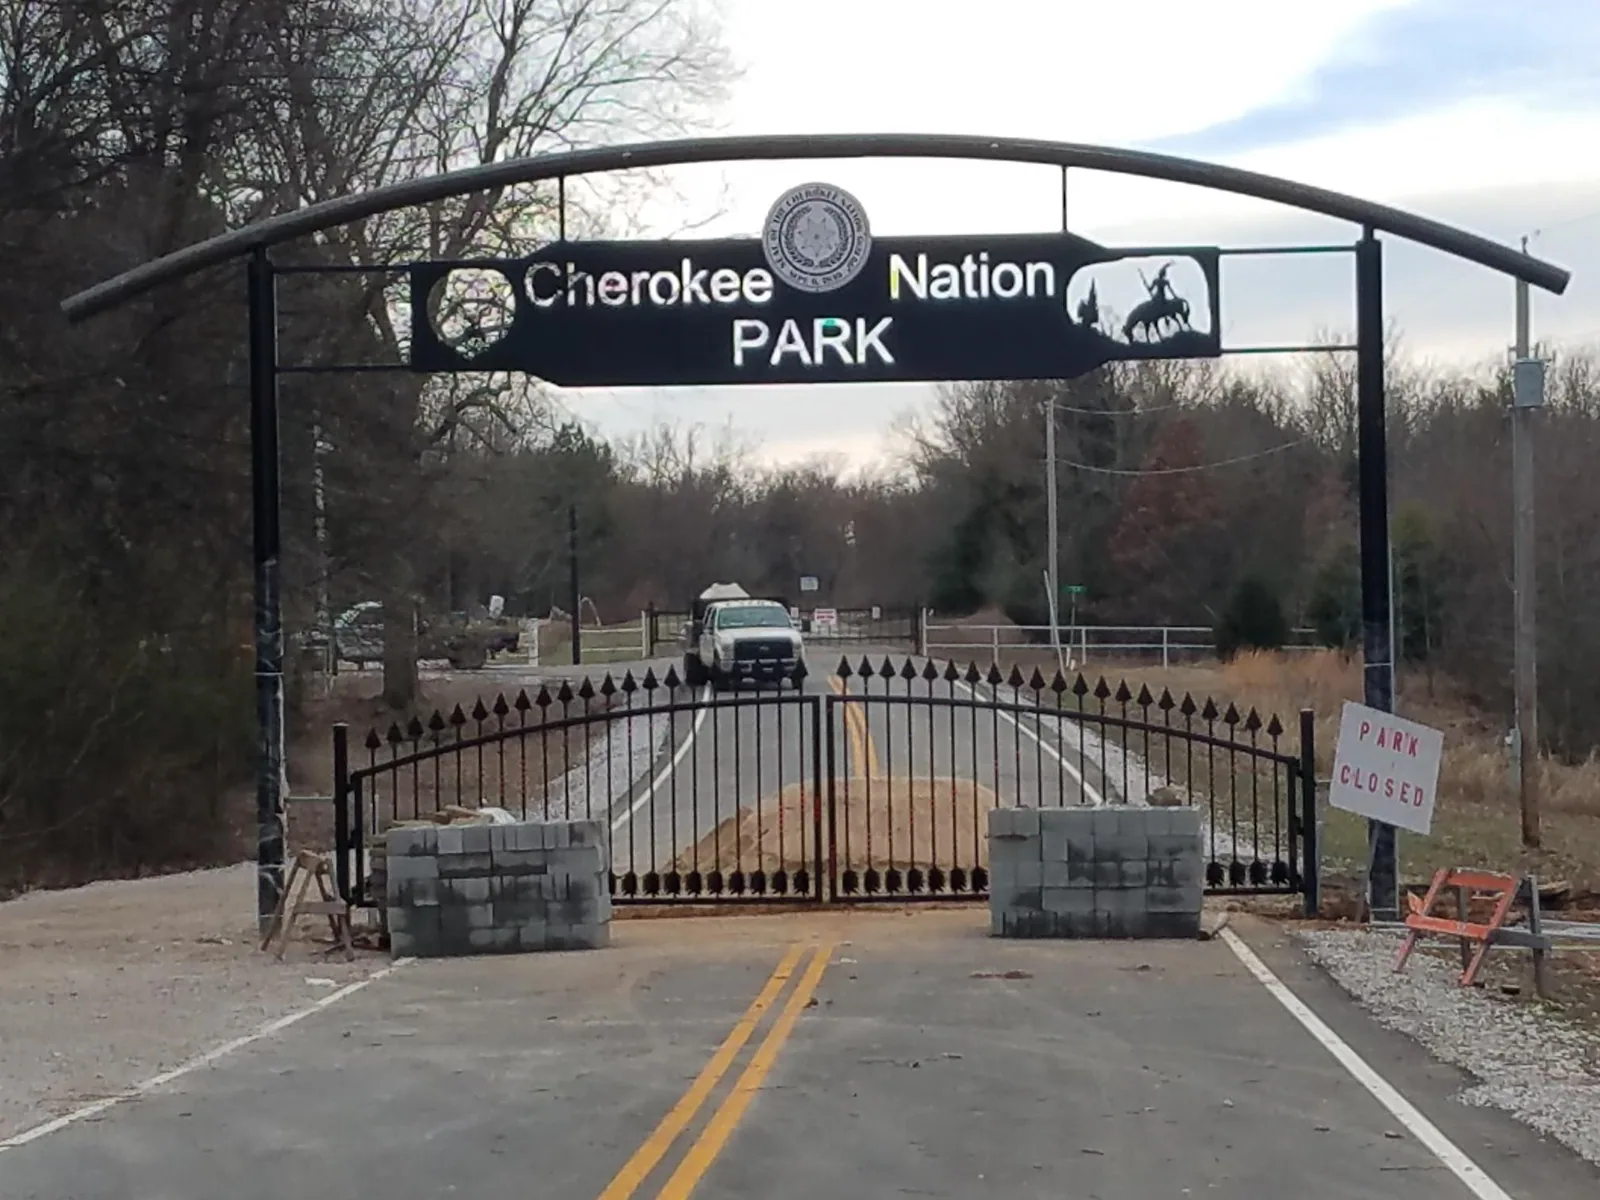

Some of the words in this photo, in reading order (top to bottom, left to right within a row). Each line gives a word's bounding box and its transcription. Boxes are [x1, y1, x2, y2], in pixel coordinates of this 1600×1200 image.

[524, 258, 774, 307] Cherokee
[889, 251, 1055, 299] Nation
[733, 316, 895, 366] PARK
[1360, 721, 1420, 758] PARK
[1340, 764, 1424, 807] CLOSED
